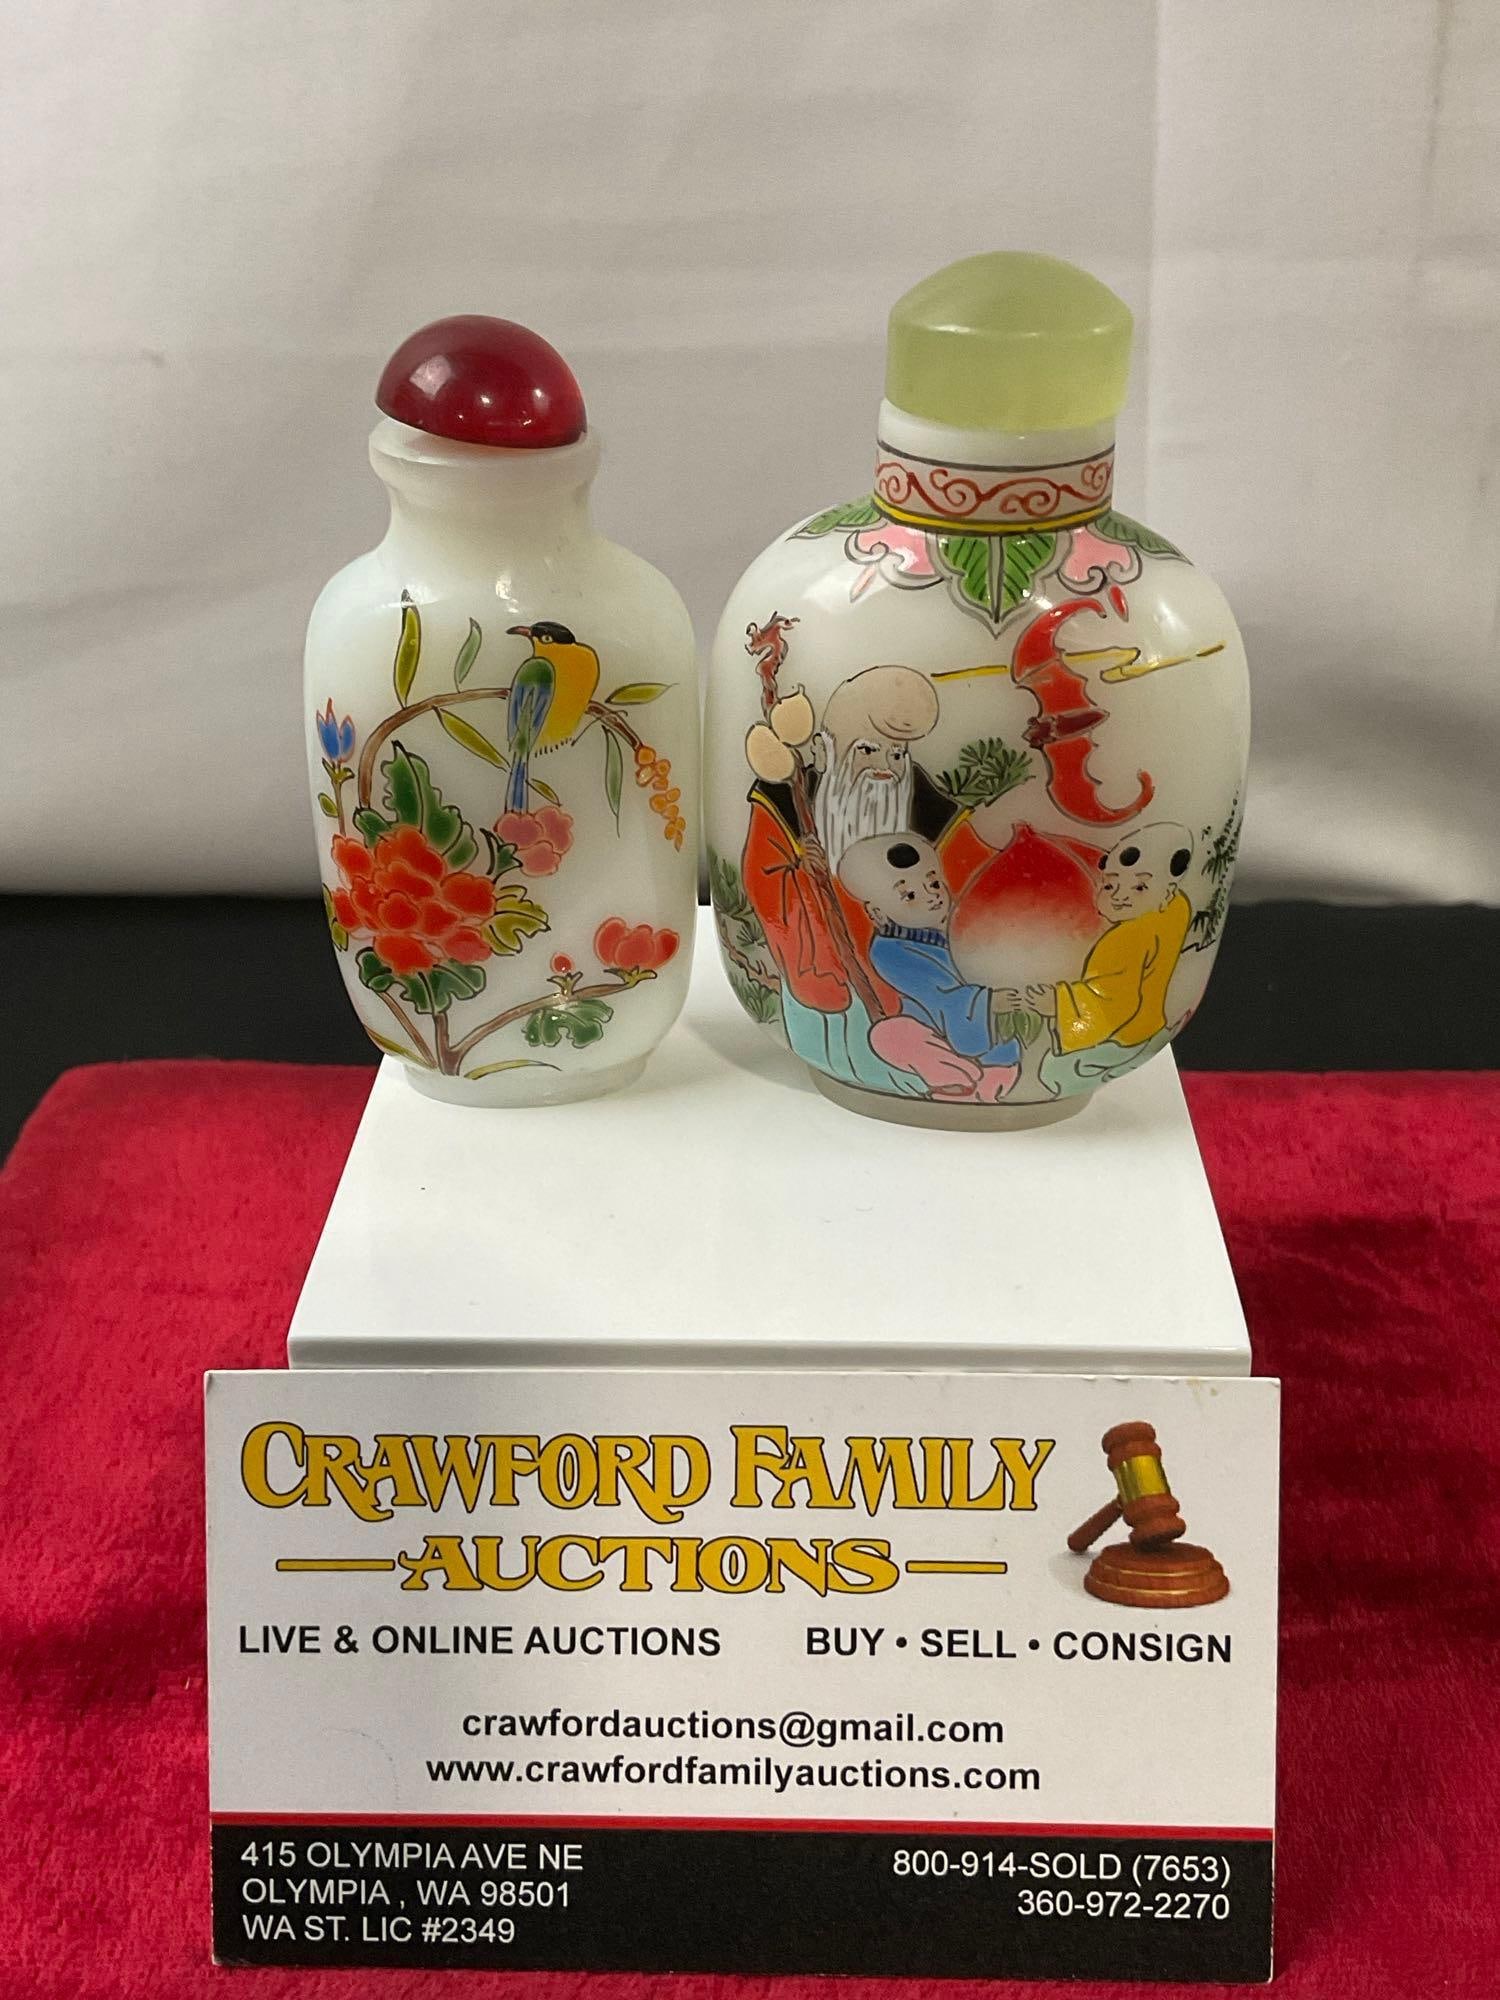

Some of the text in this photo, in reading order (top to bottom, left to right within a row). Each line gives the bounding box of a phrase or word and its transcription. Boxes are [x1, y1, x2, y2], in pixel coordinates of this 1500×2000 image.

[398, 1535, 899, 1597] AUCTIONS
[240, 1625, 720, 1656] LIVE & ONLINE AUCTIONS
[807, 1627, 1231, 1663] BUY SELL CONSIGN
[463, 1708, 1003, 1748] crawfordauctions@gmail.com
[424, 1755, 1039, 1793] www.crawfordfamilyauctions.com
[241, 1842, 583, 1870] 415 OLYMPIA AVE NE
[894, 1850, 1230, 1888] 800-914-SOLD (7653)
[417, 1881, 470, 1905] WA
[481, 1881, 567, 1907] 98501
[1018, 1890, 1229, 1919] 360-972-2270
[243, 1915, 514, 1943] WA ST. LIC #2349
